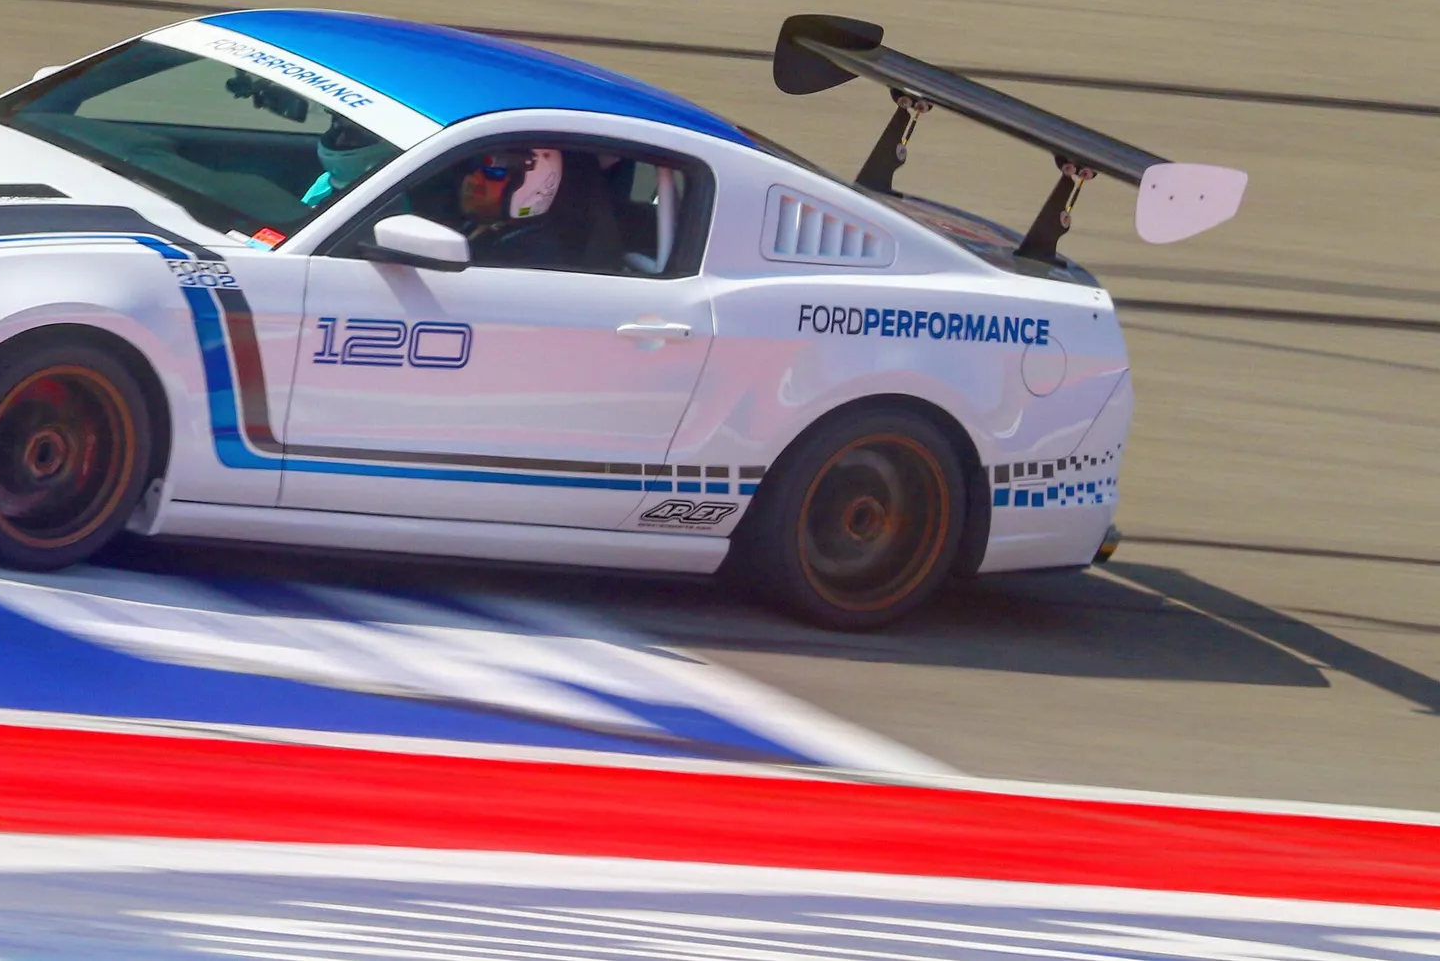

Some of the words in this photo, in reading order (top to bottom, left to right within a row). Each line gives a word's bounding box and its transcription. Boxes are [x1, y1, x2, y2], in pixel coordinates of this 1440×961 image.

[205, 39, 374, 109] FORDPERFORMANCE
[167, 260, 230, 275] FORD
[176, 273, 240, 288] 302
[797, 304, 1050, 345] FORDPERFORMANCE
[312, 317, 472, 368] 120
[641, 500, 738, 524] APEX
